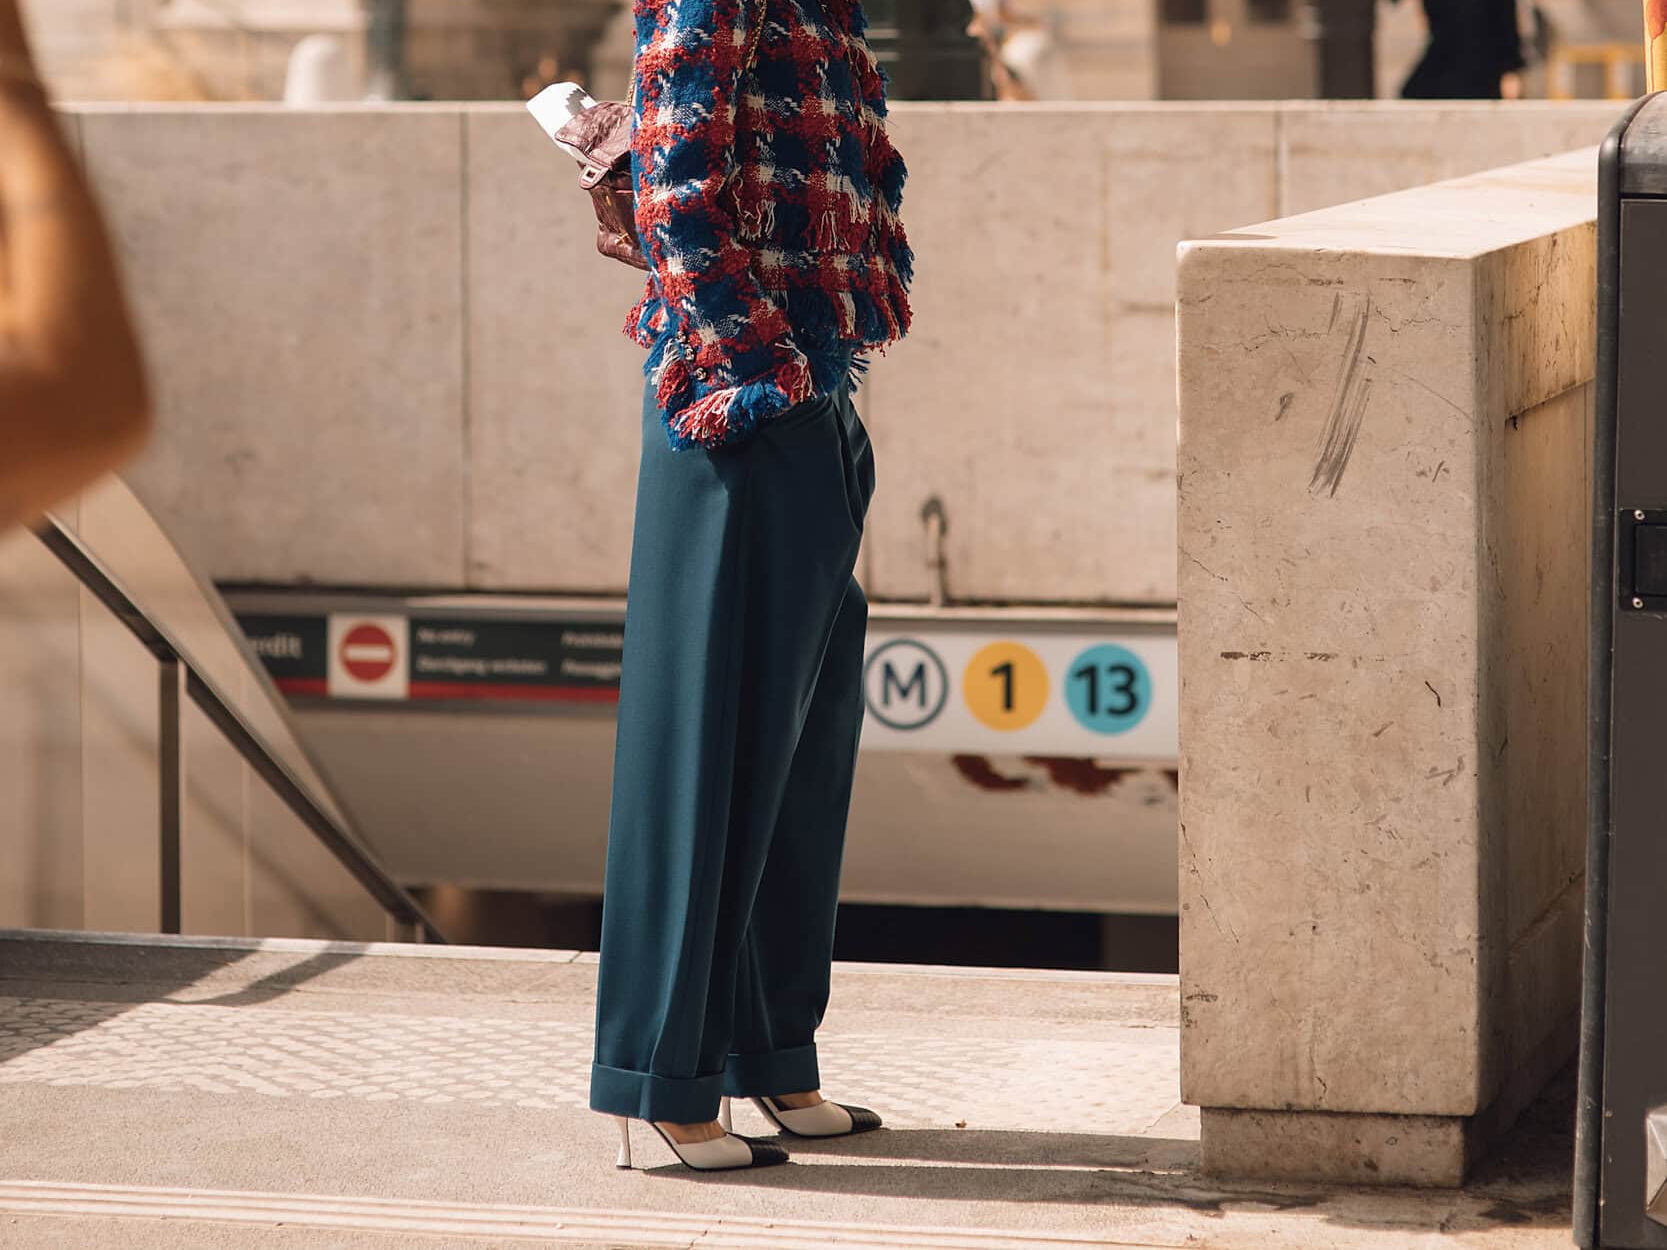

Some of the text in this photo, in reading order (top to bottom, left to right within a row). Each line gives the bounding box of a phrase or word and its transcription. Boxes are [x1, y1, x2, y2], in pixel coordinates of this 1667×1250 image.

[882, 660, 1139, 718] M 1 13
